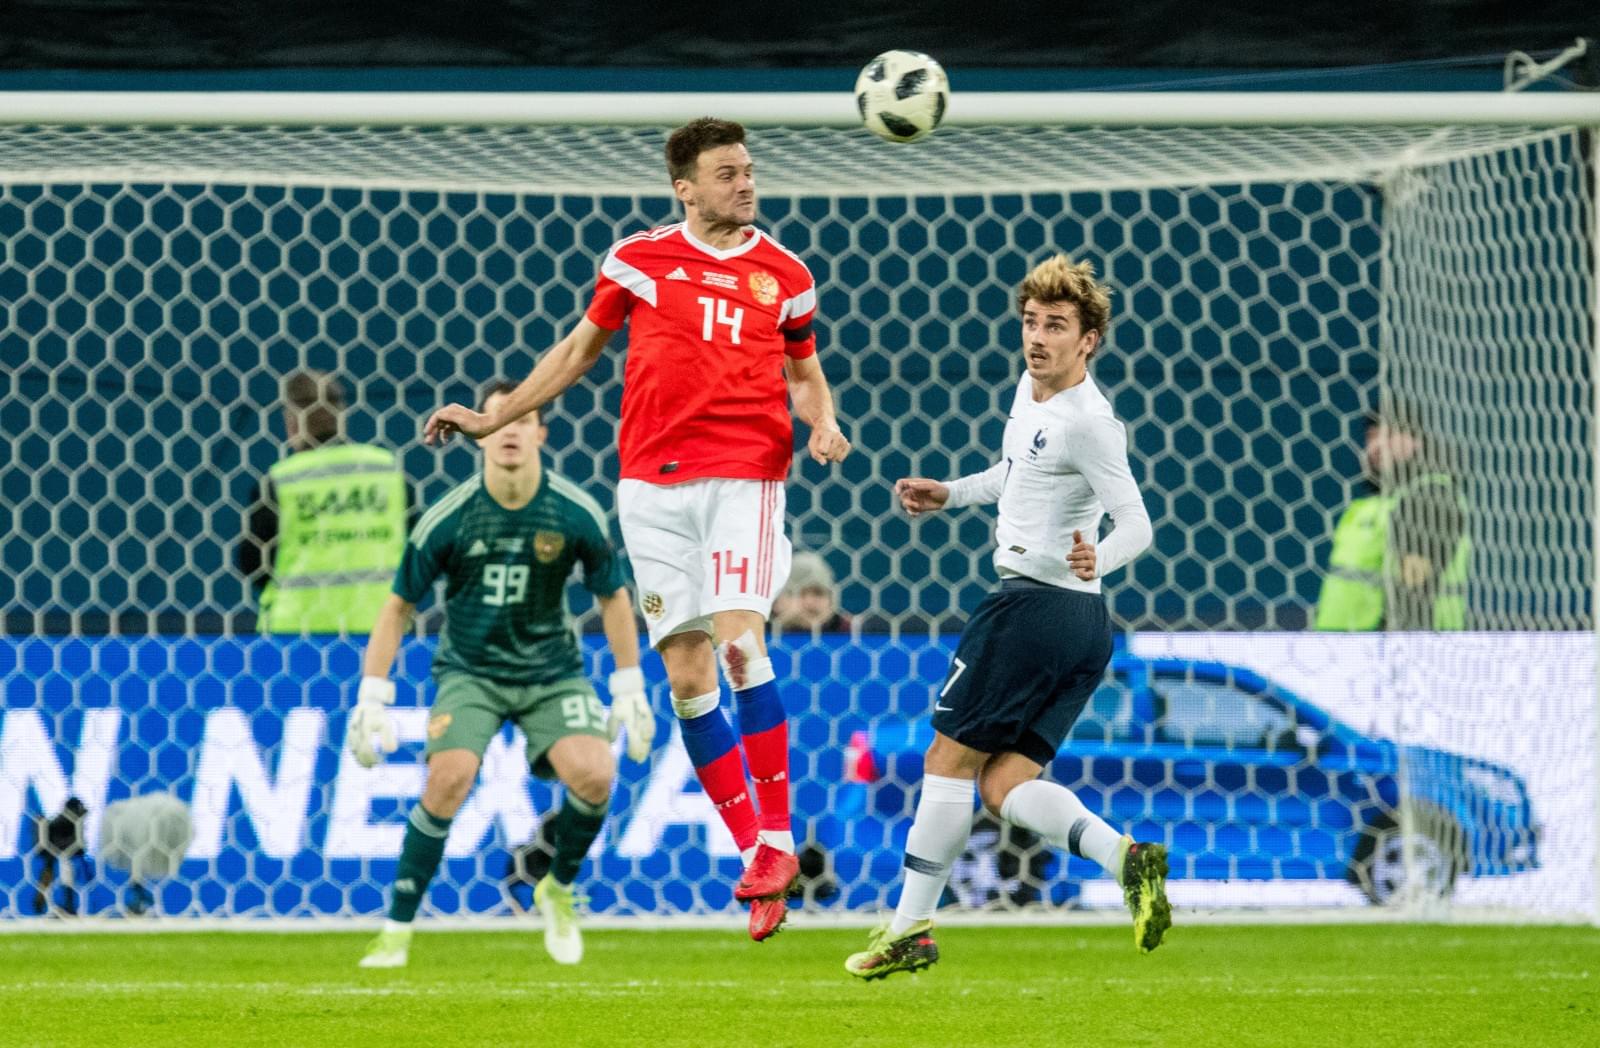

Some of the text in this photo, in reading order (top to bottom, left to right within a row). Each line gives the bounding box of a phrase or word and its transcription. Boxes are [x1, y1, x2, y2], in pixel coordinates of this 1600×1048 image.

[697, 296, 744, 345] 14
[482, 563, 530, 607] 99
[712, 549, 749, 596] 14
[940, 657, 967, 697] 7
